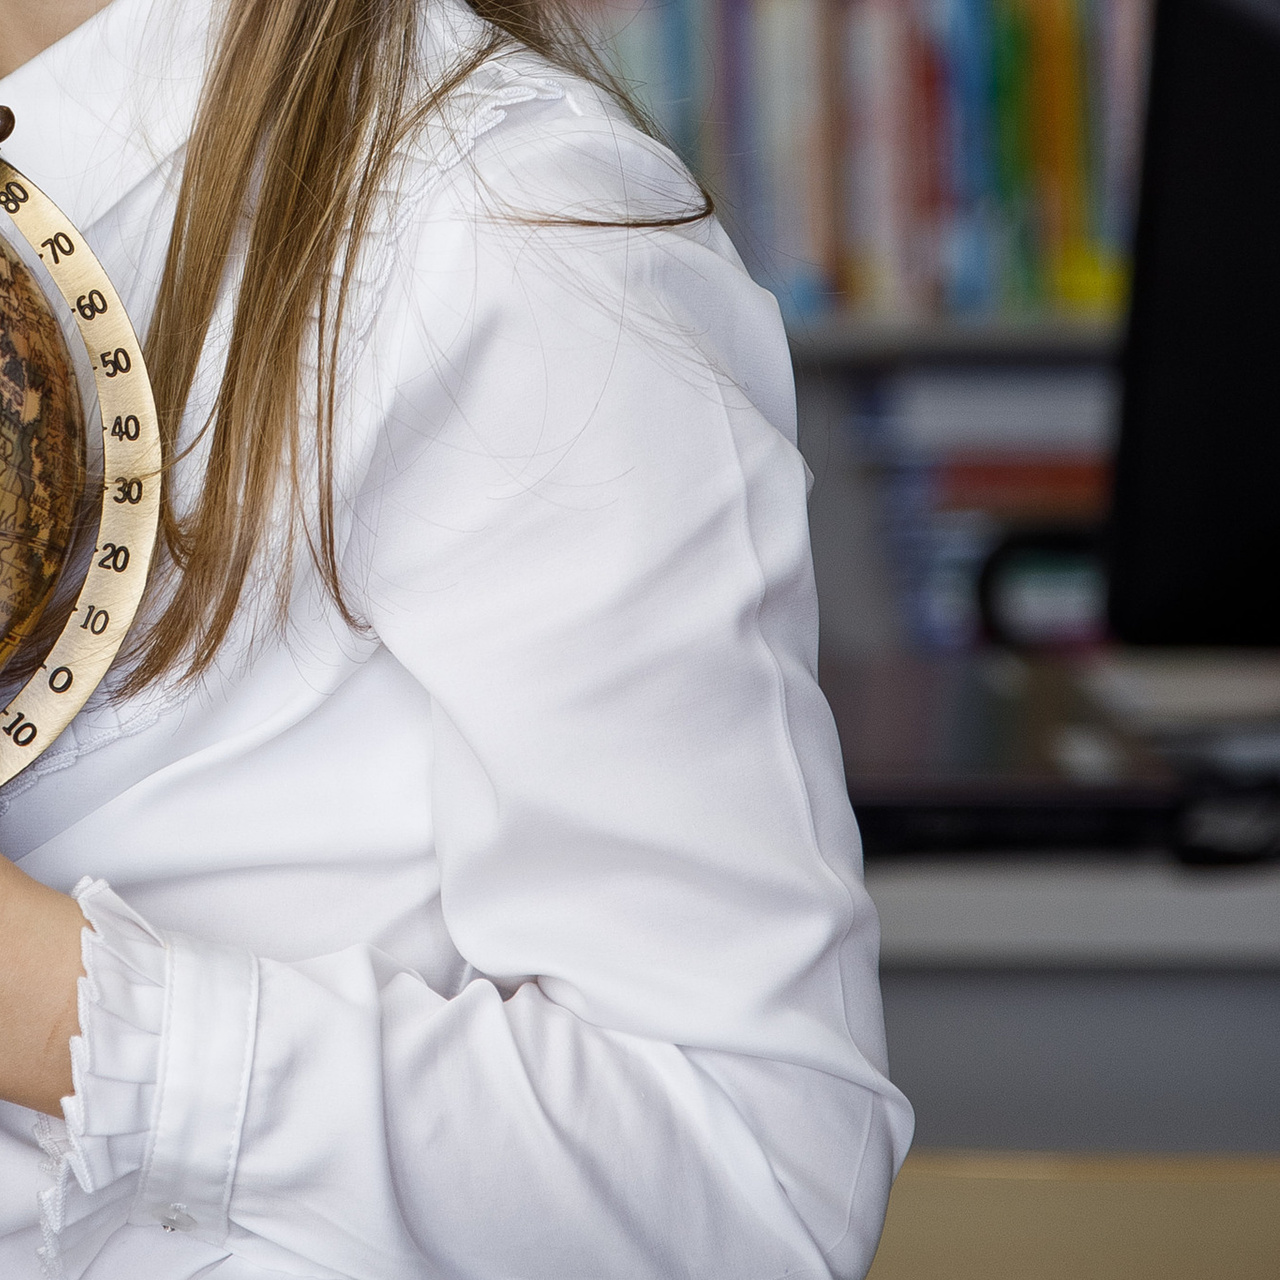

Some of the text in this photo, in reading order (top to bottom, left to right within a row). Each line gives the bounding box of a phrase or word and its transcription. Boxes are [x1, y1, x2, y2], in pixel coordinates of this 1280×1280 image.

[41, 232, 74, 264] 70
[76, 289, 107, 320] 60
[100, 348, 131, 377] 50
[111, 415, 140, 441] 40
[112, 477, 142, 505] 30
[98, 543, 129, 573] 20
[80, 605, 109, 635] 10
[49, 666, 73, 694] 0
[2, 712, 37, 747] 10
